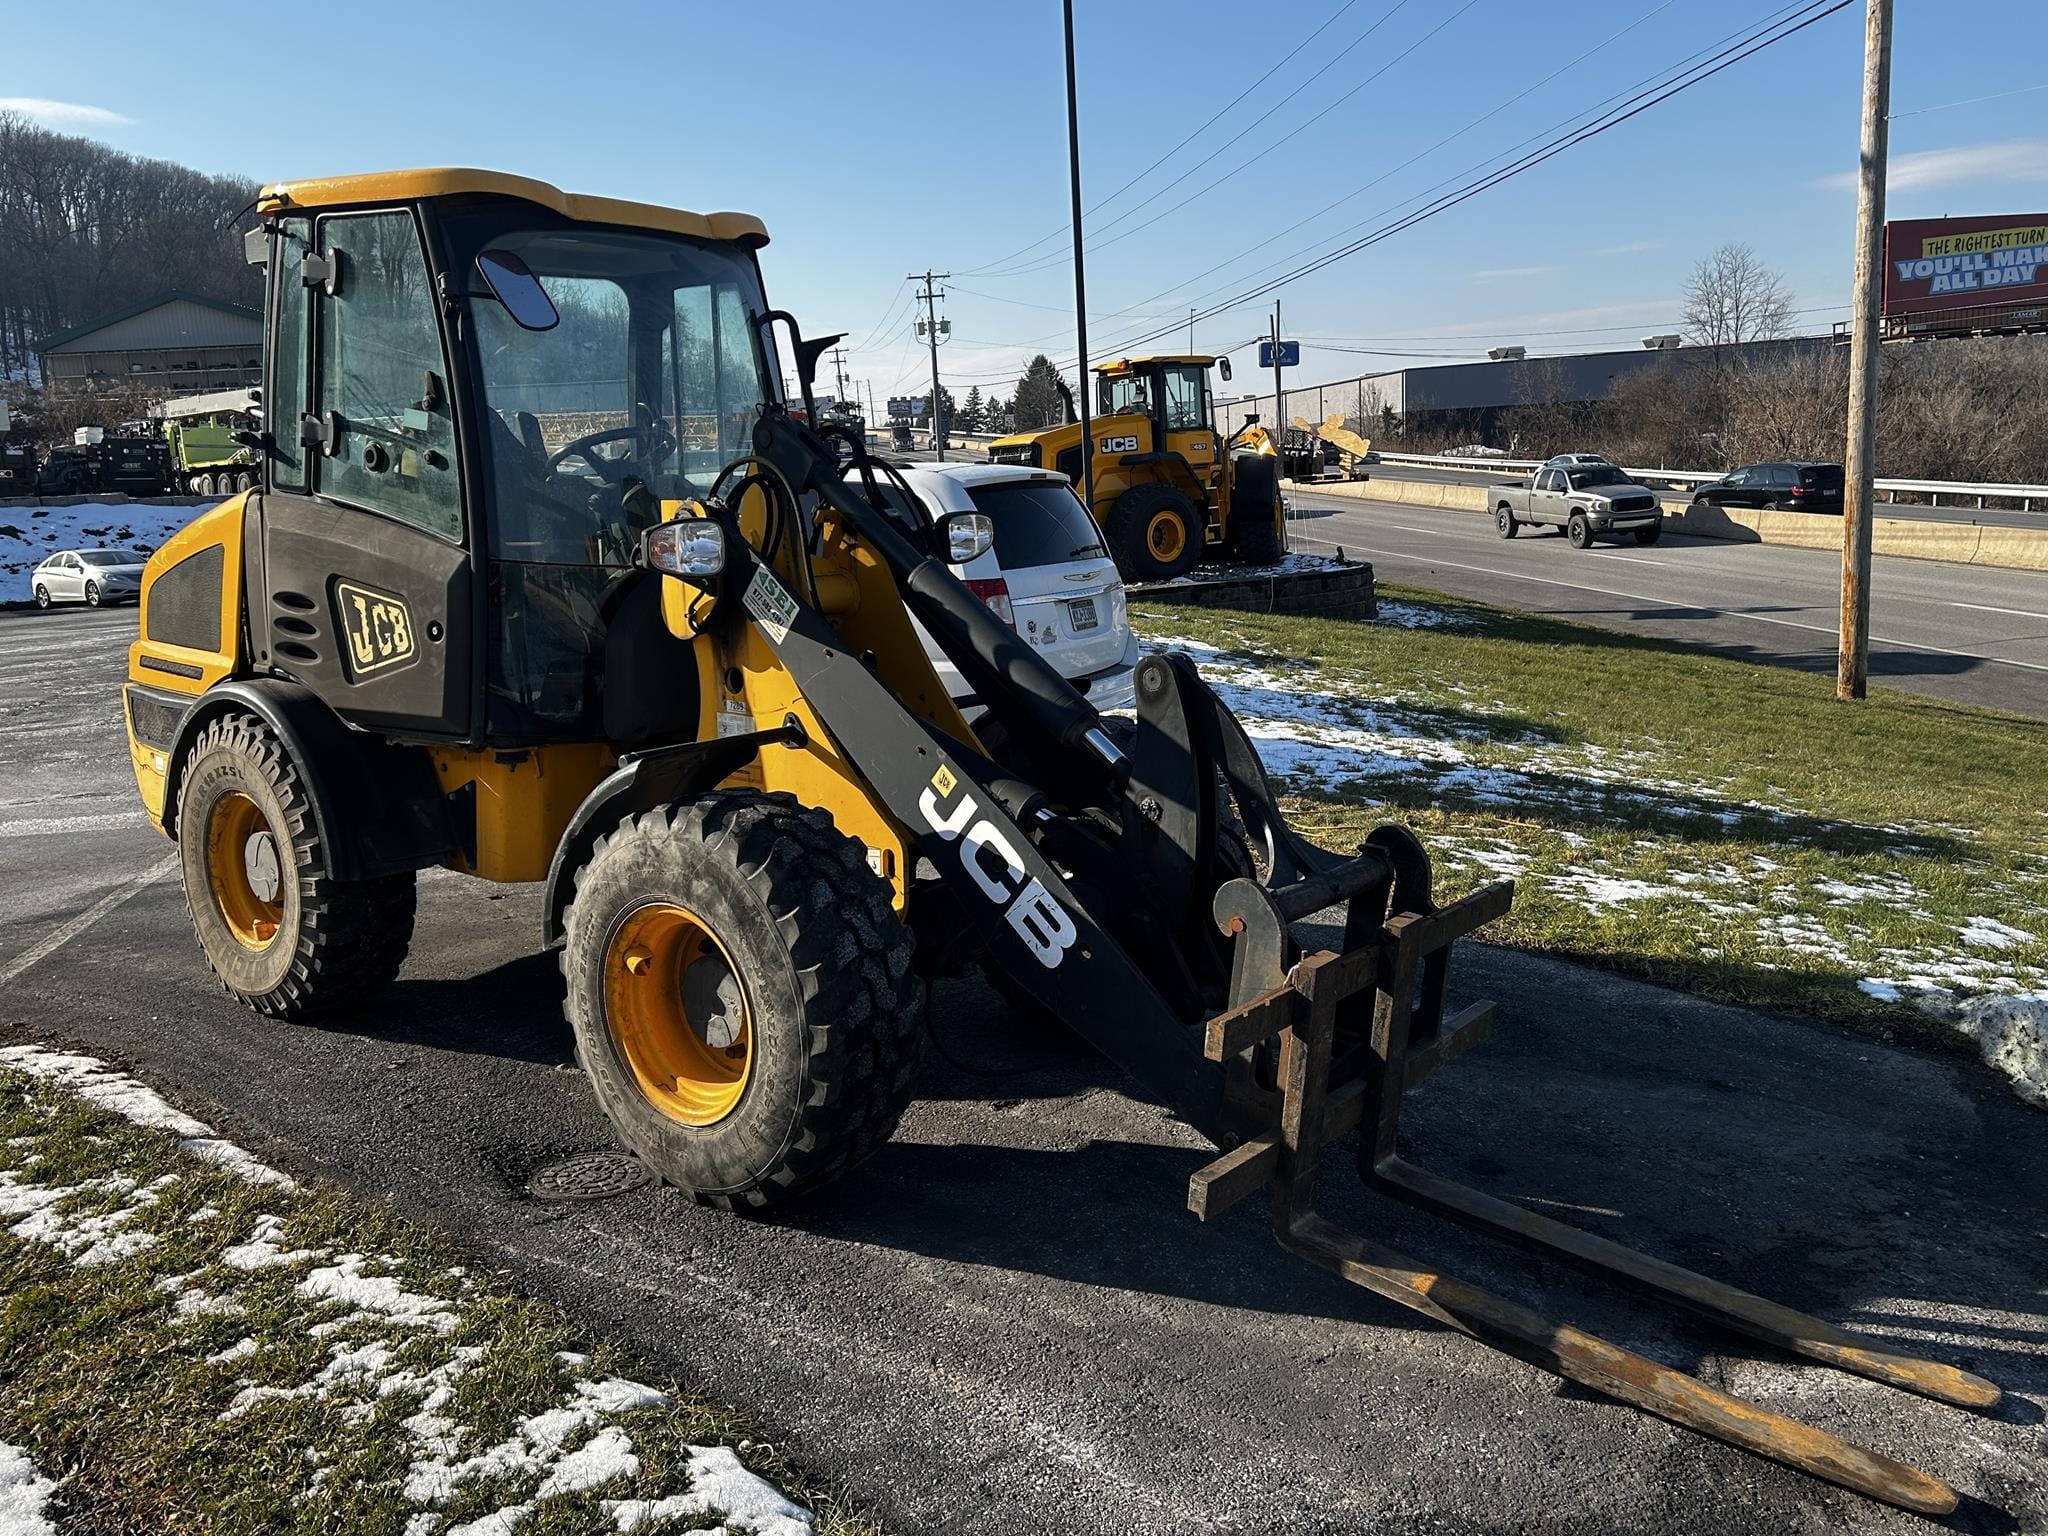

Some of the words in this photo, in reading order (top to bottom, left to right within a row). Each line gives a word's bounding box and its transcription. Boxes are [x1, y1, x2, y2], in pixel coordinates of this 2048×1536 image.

[1927, 239, 1950, 255] THE
[1954, 232, 2013, 253] RIGHTEST
[2014, 227, 2046, 246] TURN
[1897, 253, 1987, 279] YOU'LL
[1932, 272, 1978, 292] ALL
[1983, 264, 2036, 286] DAY
[1102, 436, 1138, 453] JCB
[765, 577, 797, 619] SEI
[351, 594, 409, 664] JCB
[918, 786, 1077, 969] JCB
